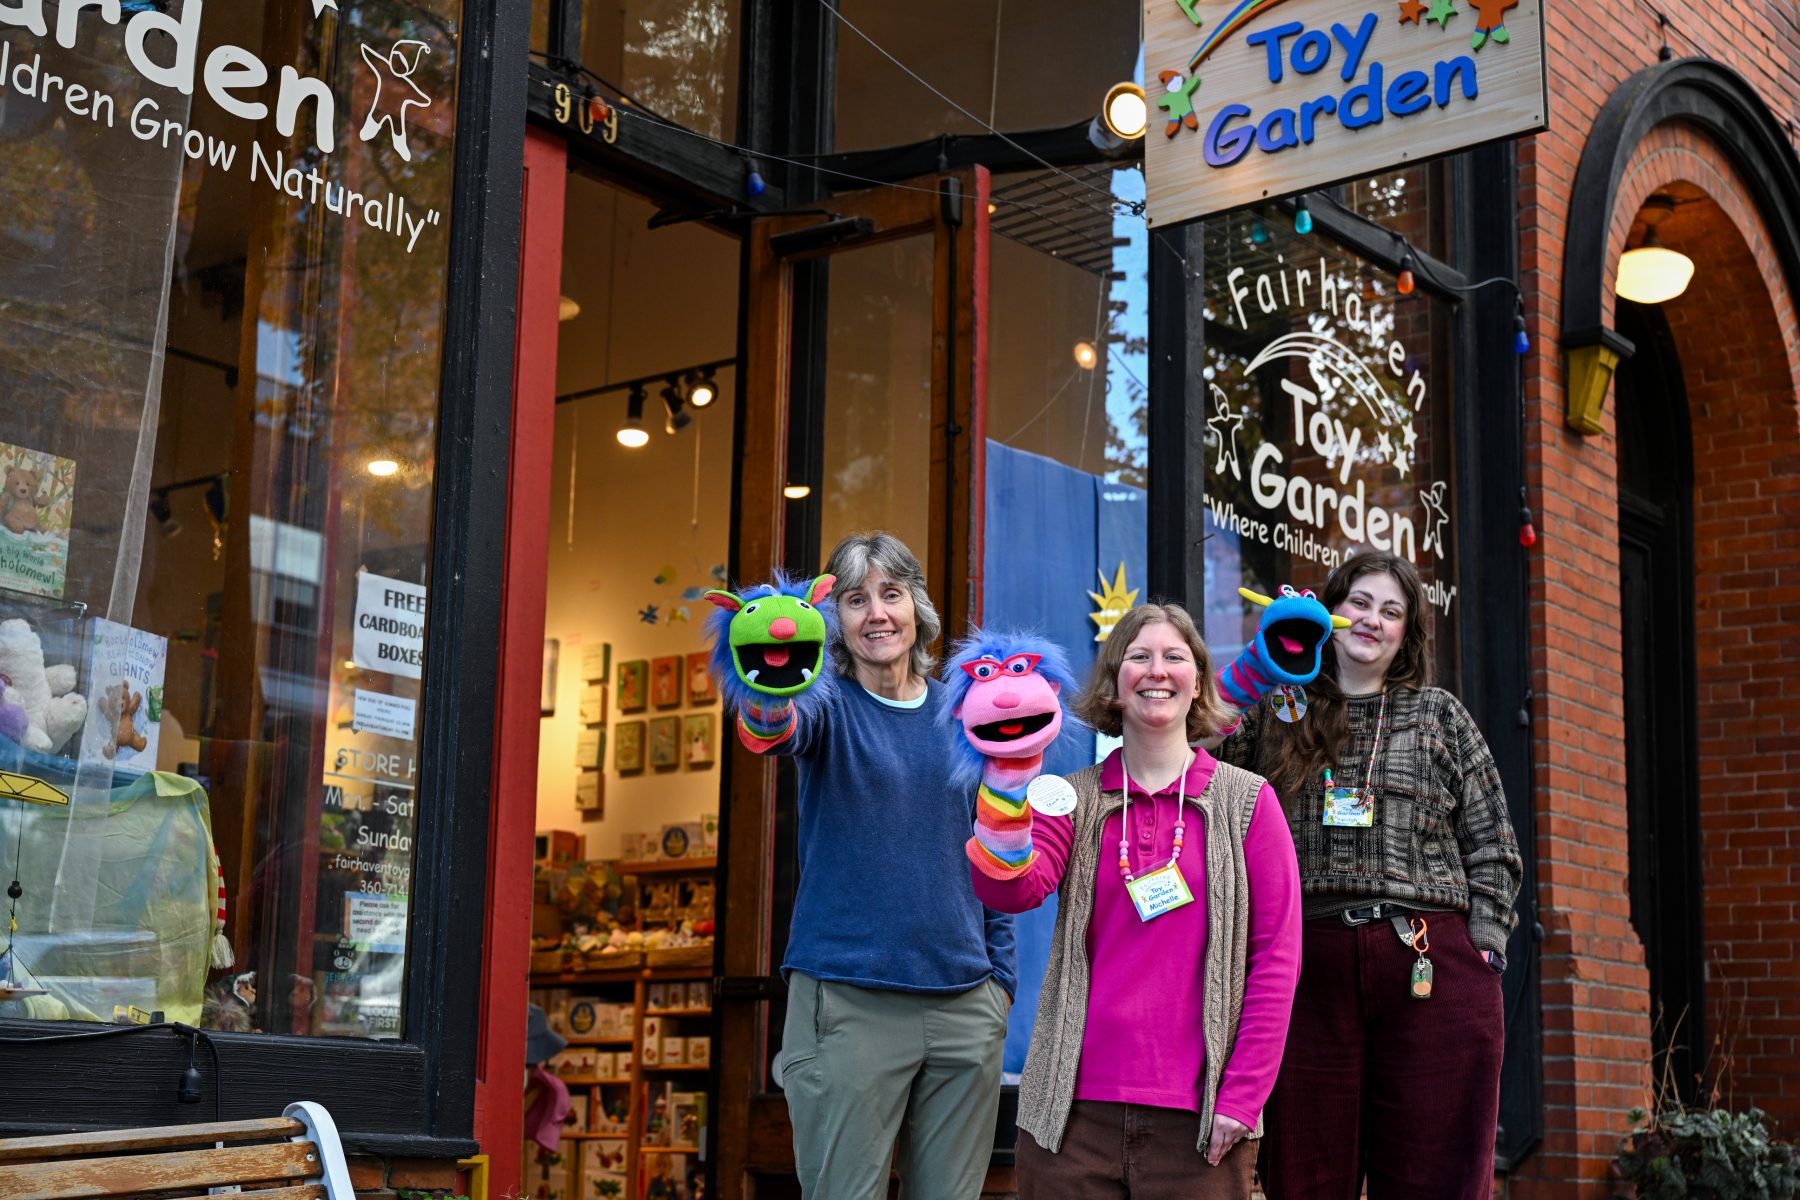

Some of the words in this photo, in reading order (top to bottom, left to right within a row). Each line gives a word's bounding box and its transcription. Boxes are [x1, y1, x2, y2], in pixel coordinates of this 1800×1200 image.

[1246, 12, 1378, 83] Toy
[554, 83, 618, 144] 909
[1203, 56, 1478, 168] Garden
[130, 97, 236, 172] Grow
[251, 140, 440, 253] Naturally"
[1281, 378, 1361, 484] Toy
[1250, 442, 1416, 562] Garden
[1204, 493, 1269, 544] "Where
[1273, 522, 1340, 568] Children
[384, 588, 426, 615] FREE
[109, 661, 150, 685] GIANTS
[335, 747, 400, 777] STORE
[1148, 887, 1174, 901] Garden
[1149, 894, 1180, 911] Michelle
[1150, 886, 1163, 894] Toy
[368, 1017, 398, 1029] FIRST
